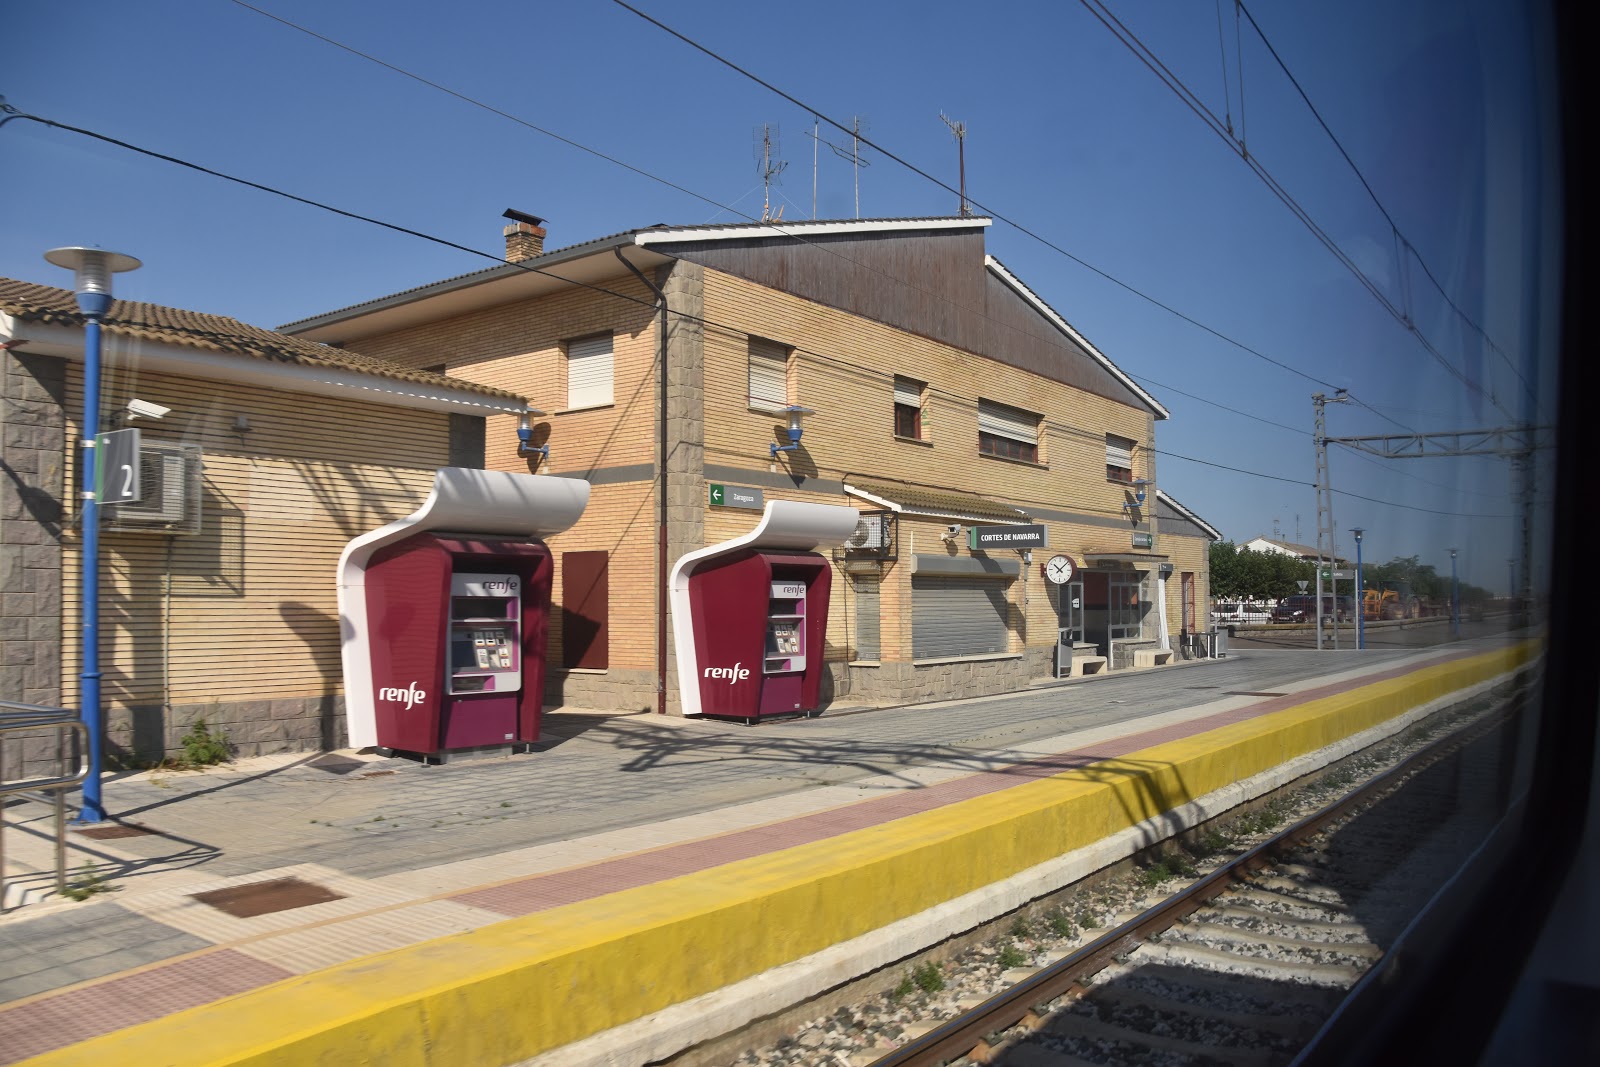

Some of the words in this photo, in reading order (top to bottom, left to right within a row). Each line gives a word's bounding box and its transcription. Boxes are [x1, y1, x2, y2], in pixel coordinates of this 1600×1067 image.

[121, 464, 133, 497] 2
[733, 493, 754, 503] Zaragoza
[980, 533, 1003, 542] CORTES
[1003, 533, 1012, 541] DE
[1012, 532, 1040, 541] NAVARRA
[482, 576, 518, 594] renfe
[783, 583, 805, 597] renfe
[704, 662, 750, 685] renfe
[379, 681, 426, 711] renfe
